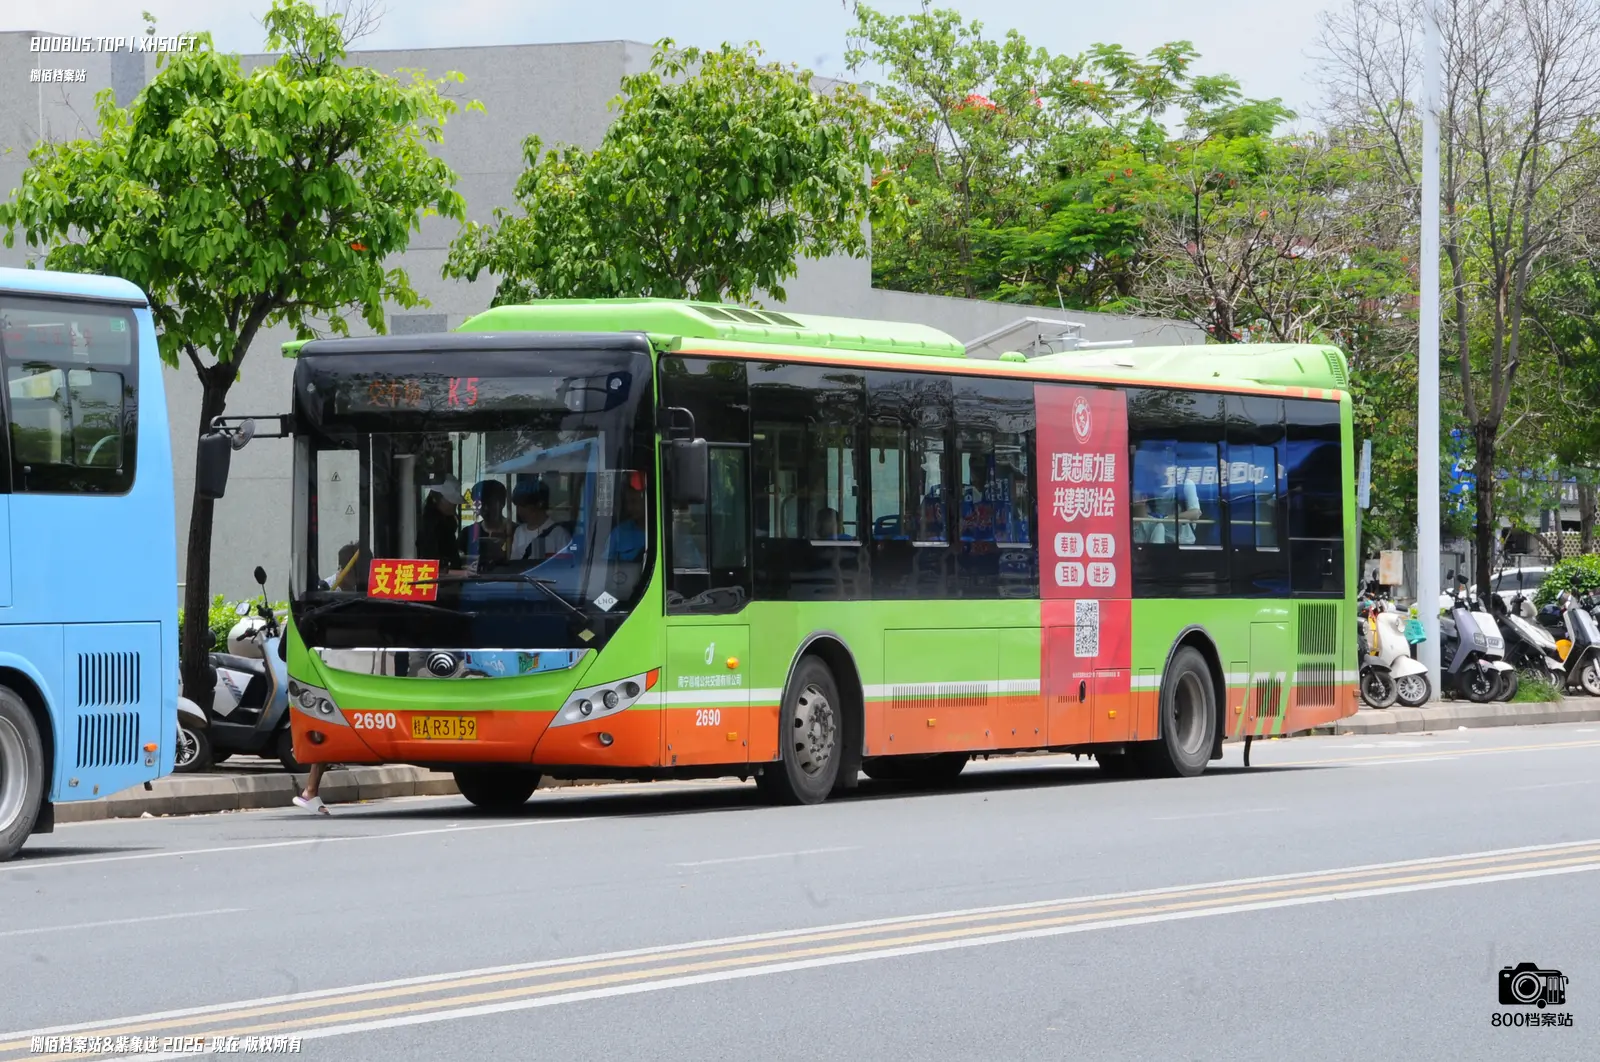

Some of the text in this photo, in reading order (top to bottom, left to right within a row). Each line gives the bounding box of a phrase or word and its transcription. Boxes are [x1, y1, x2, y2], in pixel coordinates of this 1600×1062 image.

[448, 377, 479, 406] K5
[1051, 452, 1115, 483] 汇聚志愿力量
[1053, 487, 1115, 522] 共建美好社会
[1061, 537, 1109, 554] 奉献 友爱
[371, 563, 435, 596] 支援车
[1061, 566, 1110, 583] 互助 进步
[597, 597, 614, 605] LNG
[353, 712, 397, 730] 2690
[695, 708, 721, 727] 2690
